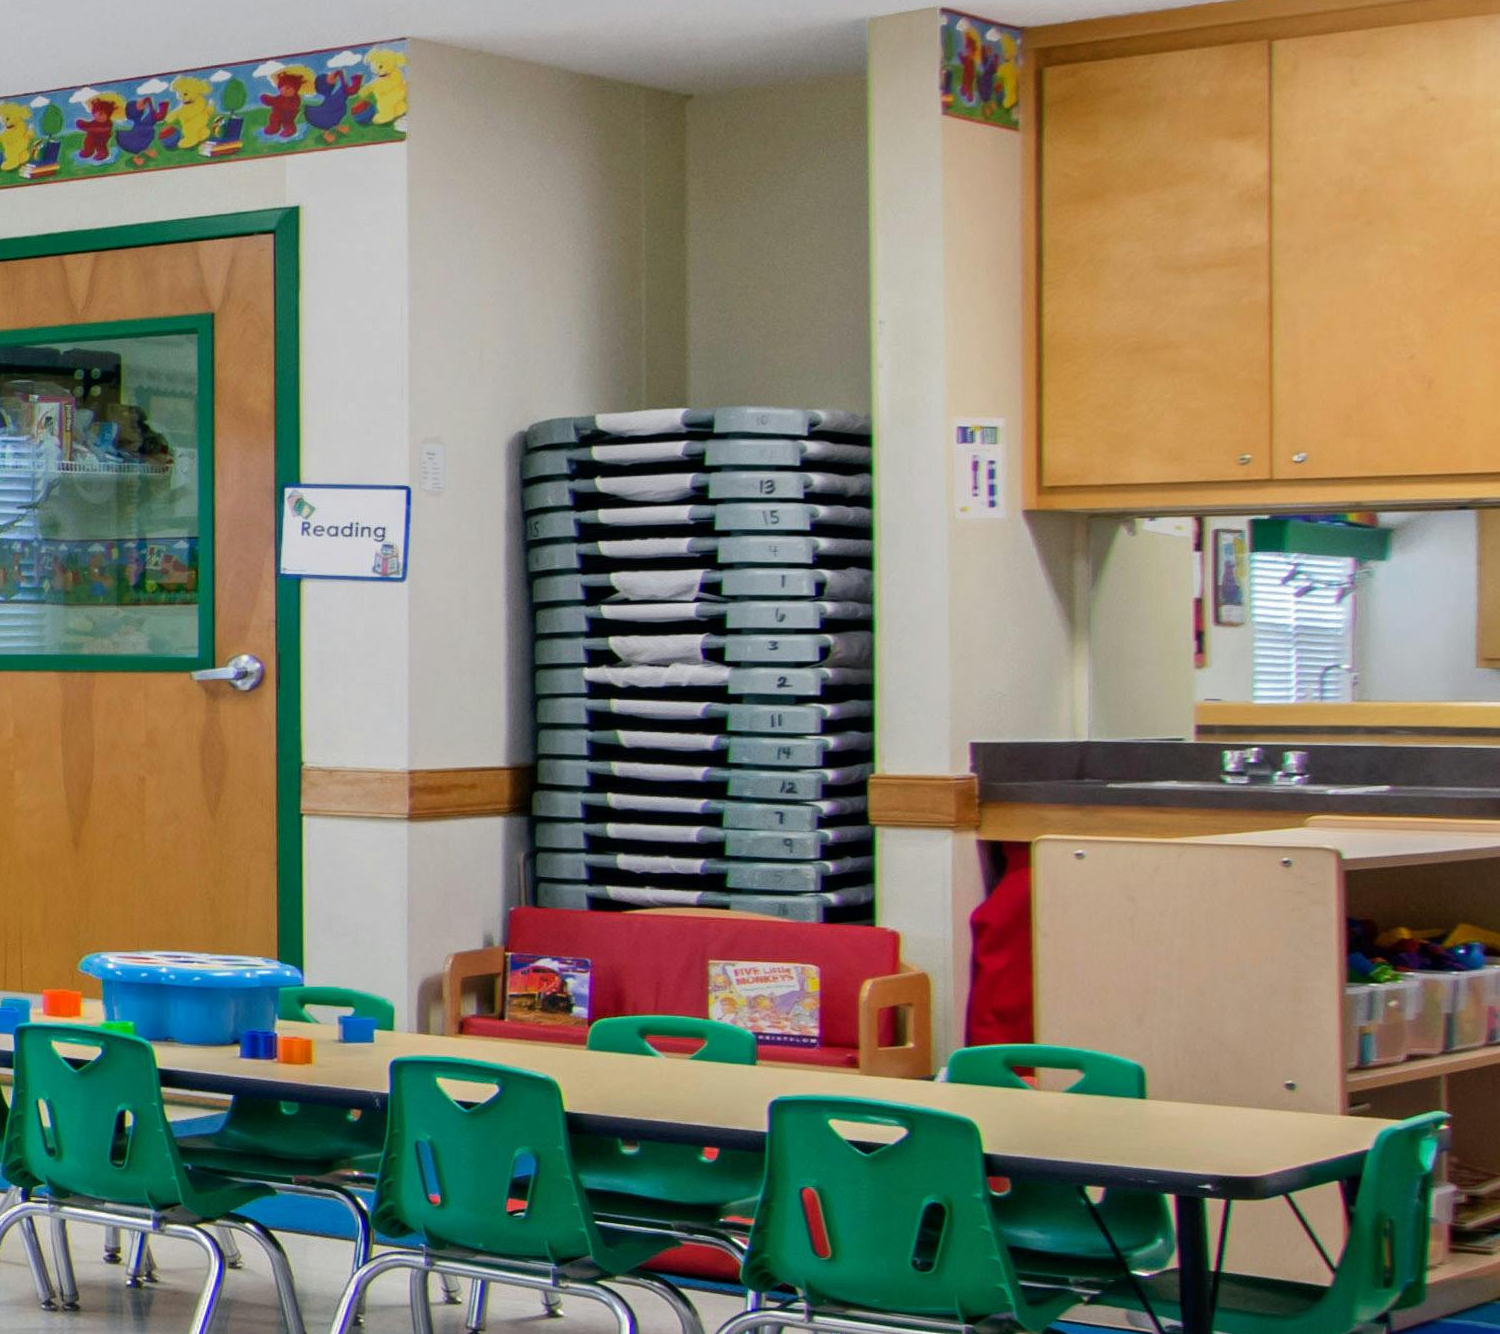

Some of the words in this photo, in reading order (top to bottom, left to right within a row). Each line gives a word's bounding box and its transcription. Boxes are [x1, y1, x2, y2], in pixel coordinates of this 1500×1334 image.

[759, 479, 776, 495] 13
[762, 510, 780, 526] 15
[301, 521, 386, 542] Reading
[781, 575, 786, 588] 1
[775, 608, 786, 623] 6
[768, 640, 779, 651] 3
[776, 676, 793, 689] 2
[770, 714, 782, 728] 11
[777, 746, 791, 760] 14
[780, 781, 798, 794] 12
[775, 811, 784, 825] 7
[783, 837, 793, 853] 9
[733, 967, 760, 977] FIVE
[735, 975, 795, 986] MONKEYS
